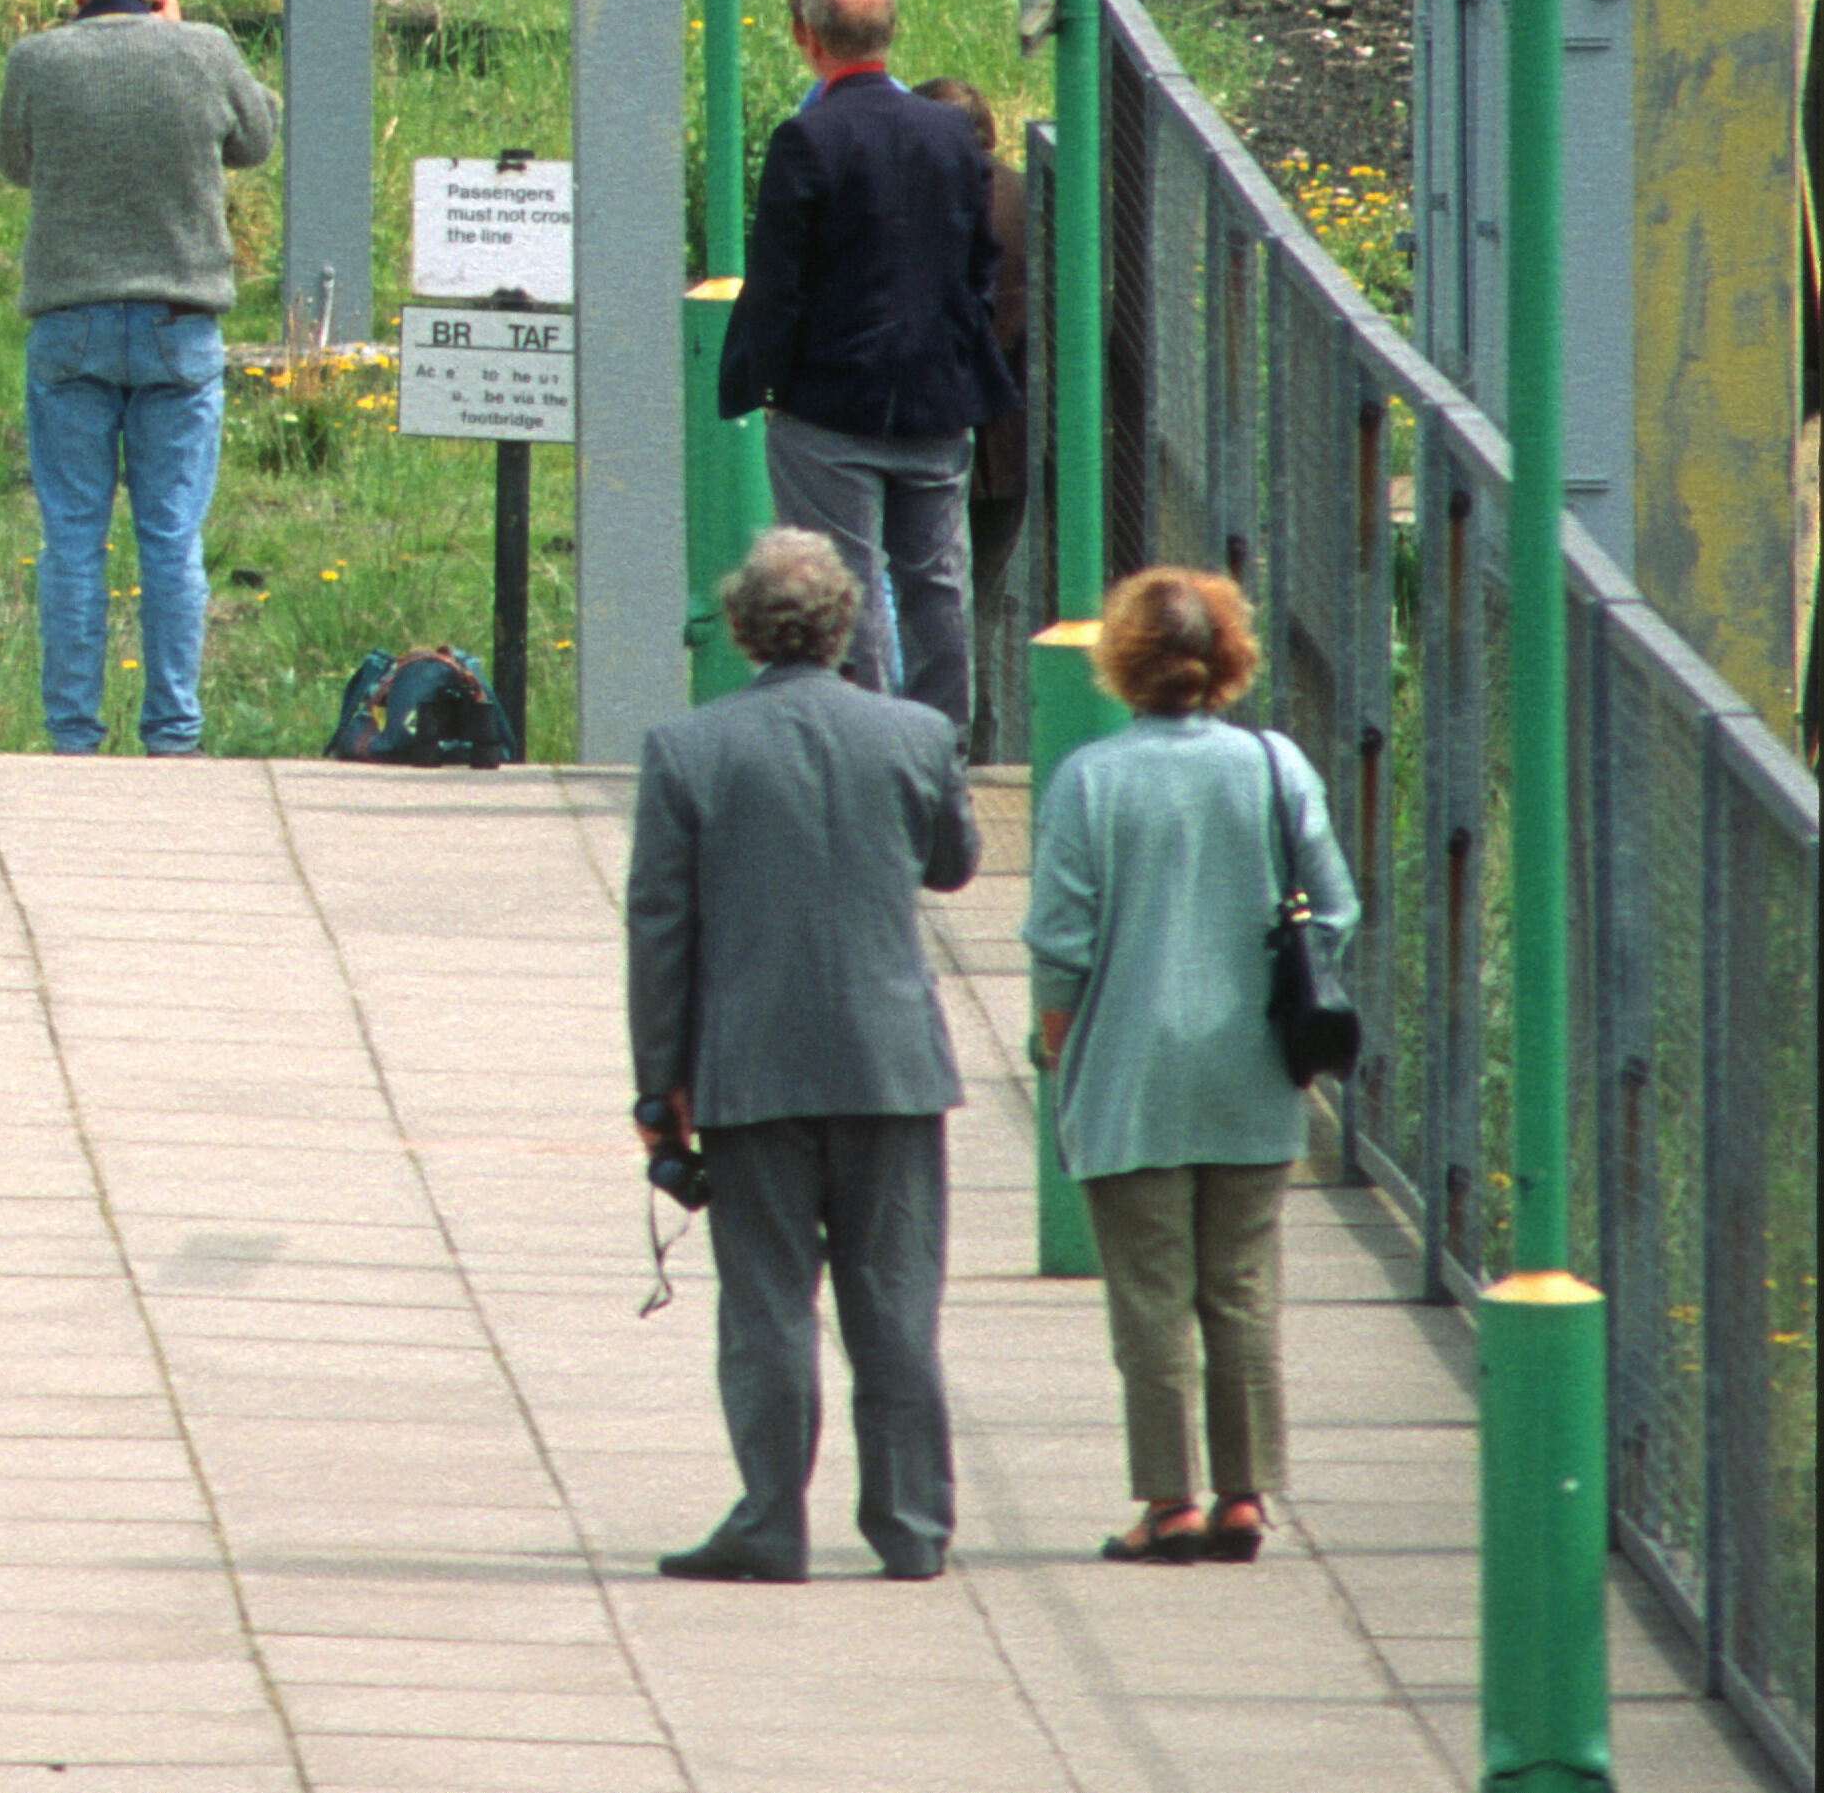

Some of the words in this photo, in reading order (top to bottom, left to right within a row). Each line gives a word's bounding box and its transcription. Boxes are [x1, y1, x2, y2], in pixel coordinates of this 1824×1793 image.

[447, 183, 555, 204] Passengers
[447, 208, 492, 222] must
[497, 209, 526, 223] not
[531, 210, 572, 224] cros
[447, 227, 477, 243] the
[480, 228, 513, 244] line
[433, 321, 472, 346] BR
[508, 324, 560, 349] TAF
[512, 370, 532, 384] he
[484, 389, 504, 404] be
[512, 392, 534, 405] via
[542, 392, 568, 407] the
[461, 410, 544, 430] footbridge
